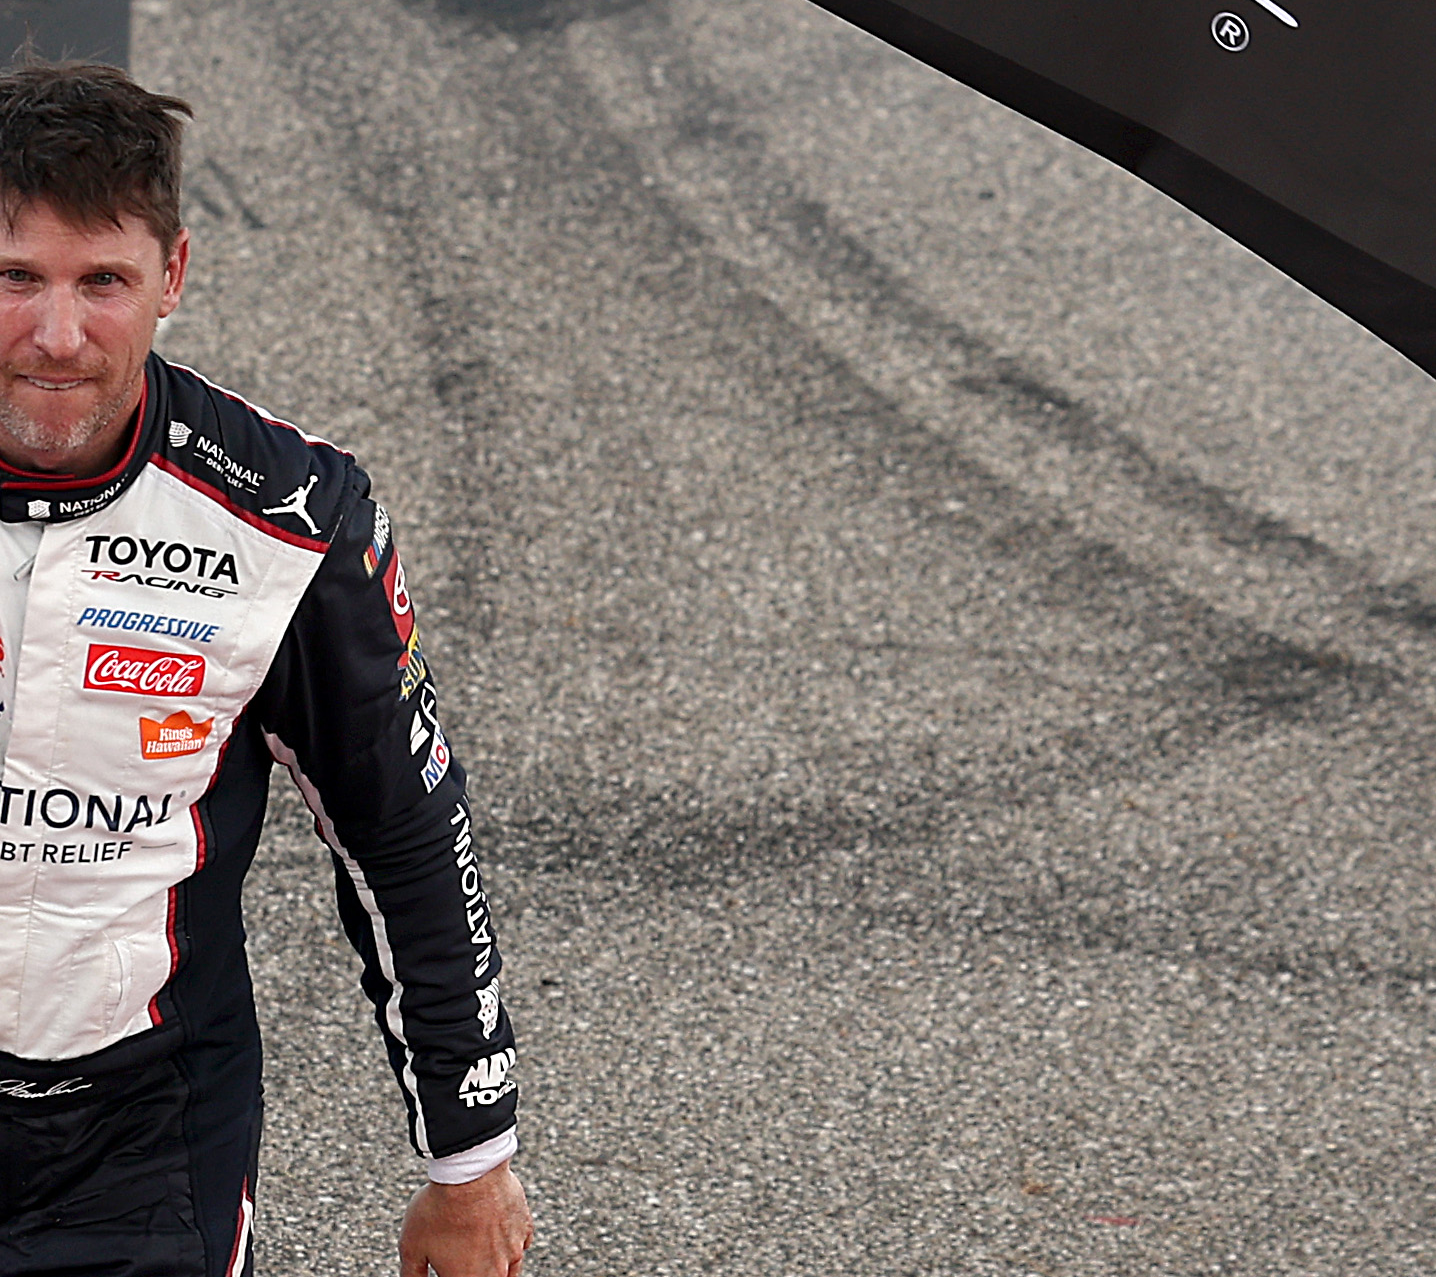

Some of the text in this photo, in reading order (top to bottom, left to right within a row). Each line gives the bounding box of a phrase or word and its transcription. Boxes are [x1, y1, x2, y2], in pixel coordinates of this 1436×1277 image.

[85, 535, 240, 585] TOYOTA
[81, 569, 239, 599] RACING
[77, 607, 220, 643] PROGRESSIVE
[88, 650, 194, 695] Coca-Cola
[146, 735, 204, 754] Hawaiian
[158, 726, 194, 742] King's
[42, 839, 134, 864] RELIEF
